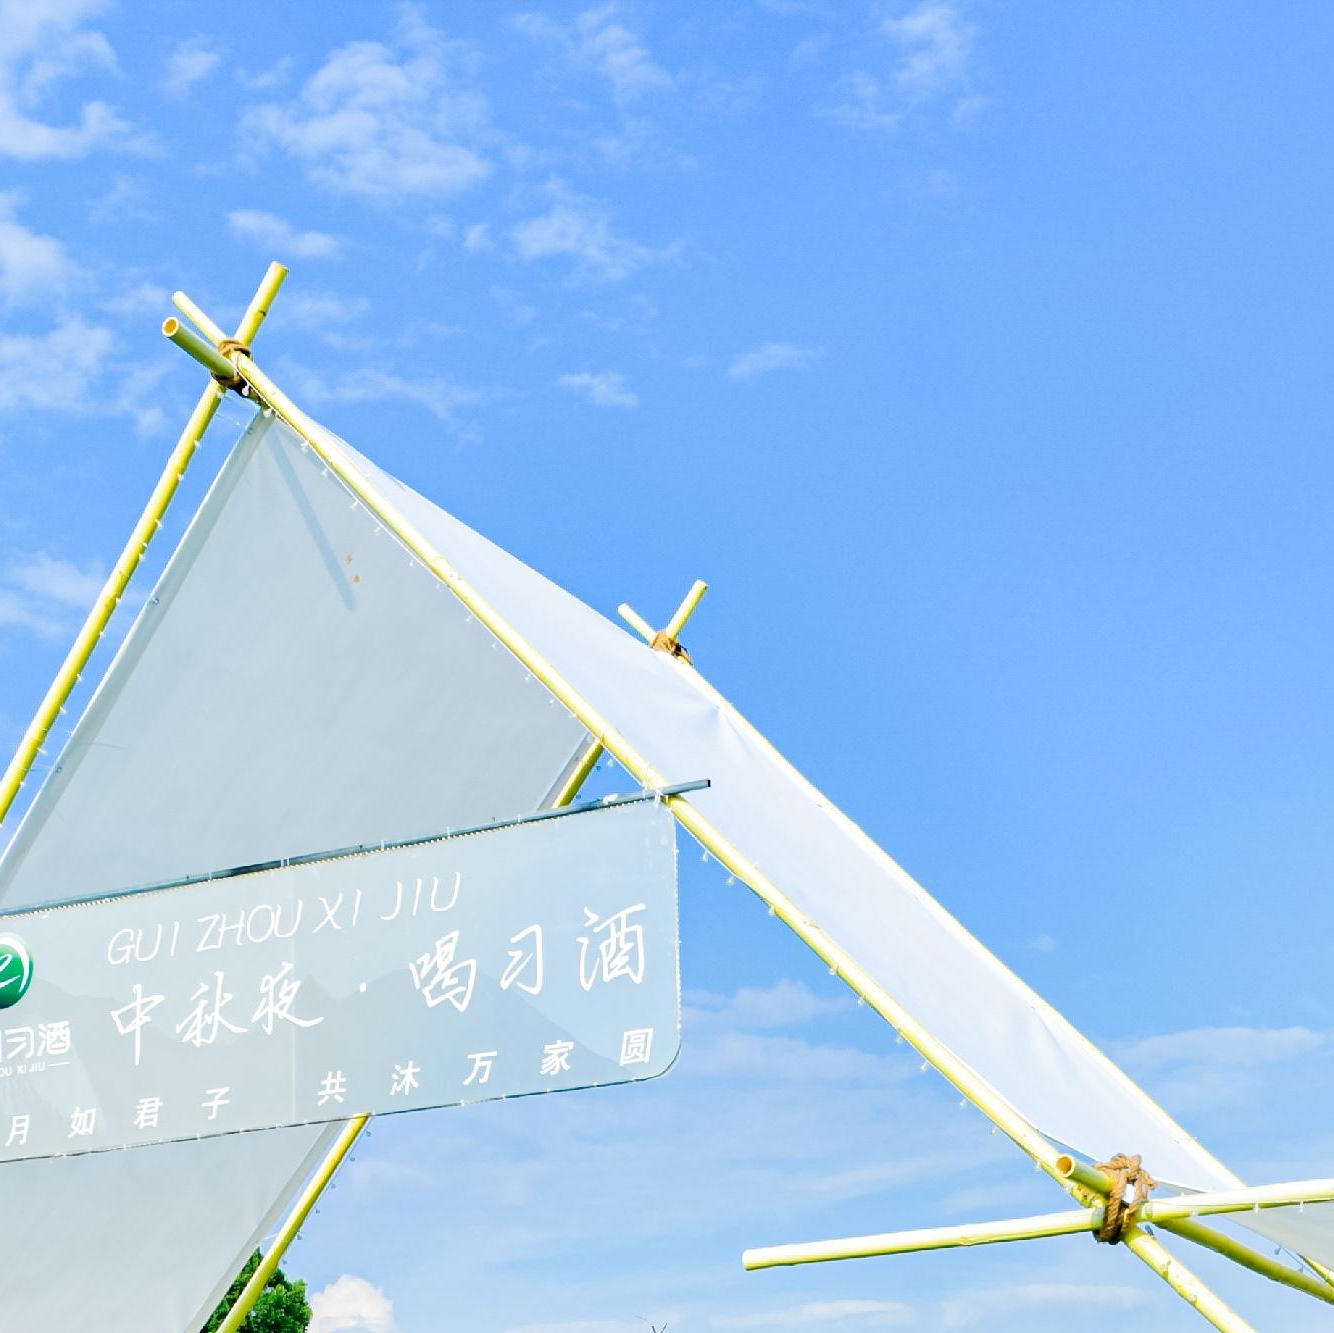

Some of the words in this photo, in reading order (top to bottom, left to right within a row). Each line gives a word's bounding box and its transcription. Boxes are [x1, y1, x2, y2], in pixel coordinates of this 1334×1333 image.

[107, 921, 180, 965] GUI
[196, 899, 303, 952] ZHOU
[312, 889, 362, 933] XI
[380, 871, 461, 921] JIU
[17, 1064, 27, 1075] XI
